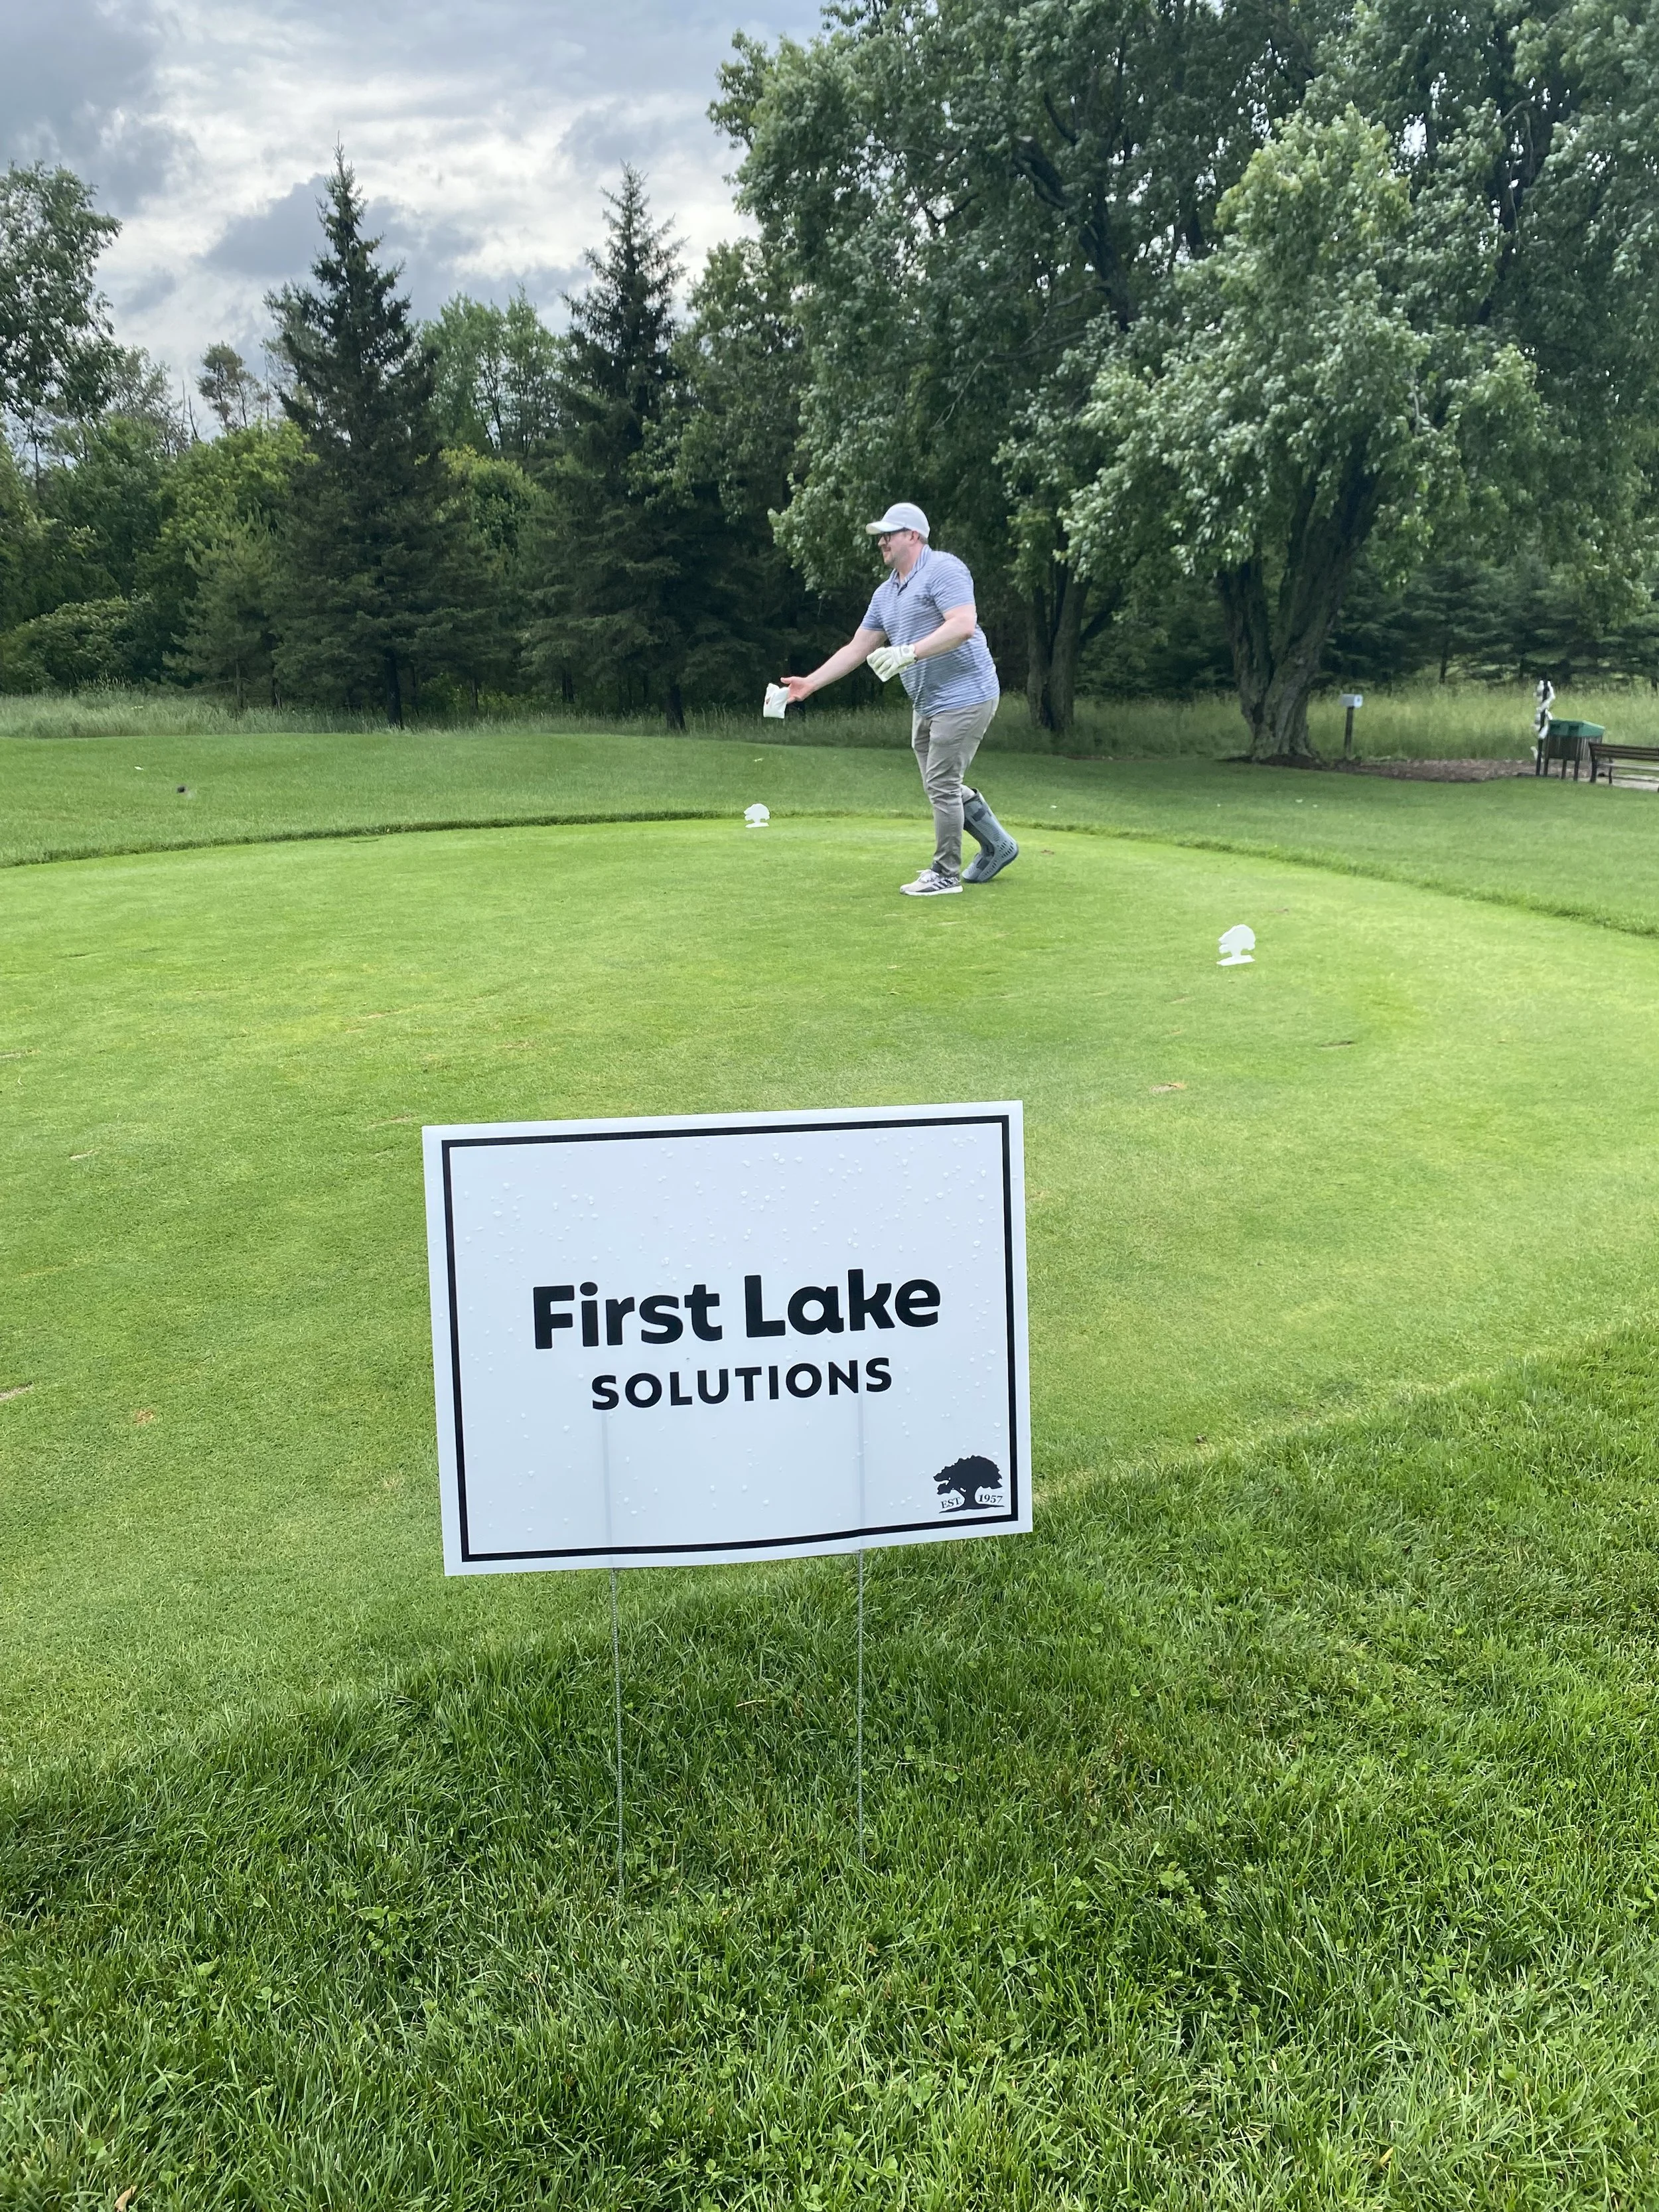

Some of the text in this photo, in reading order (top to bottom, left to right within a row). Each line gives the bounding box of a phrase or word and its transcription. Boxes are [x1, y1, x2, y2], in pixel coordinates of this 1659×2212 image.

[532, 1268, 941, 1350] First Lake
[591, 1357, 893, 1410] SOLUTIONS
[979, 1494, 1003, 1504] 1957
